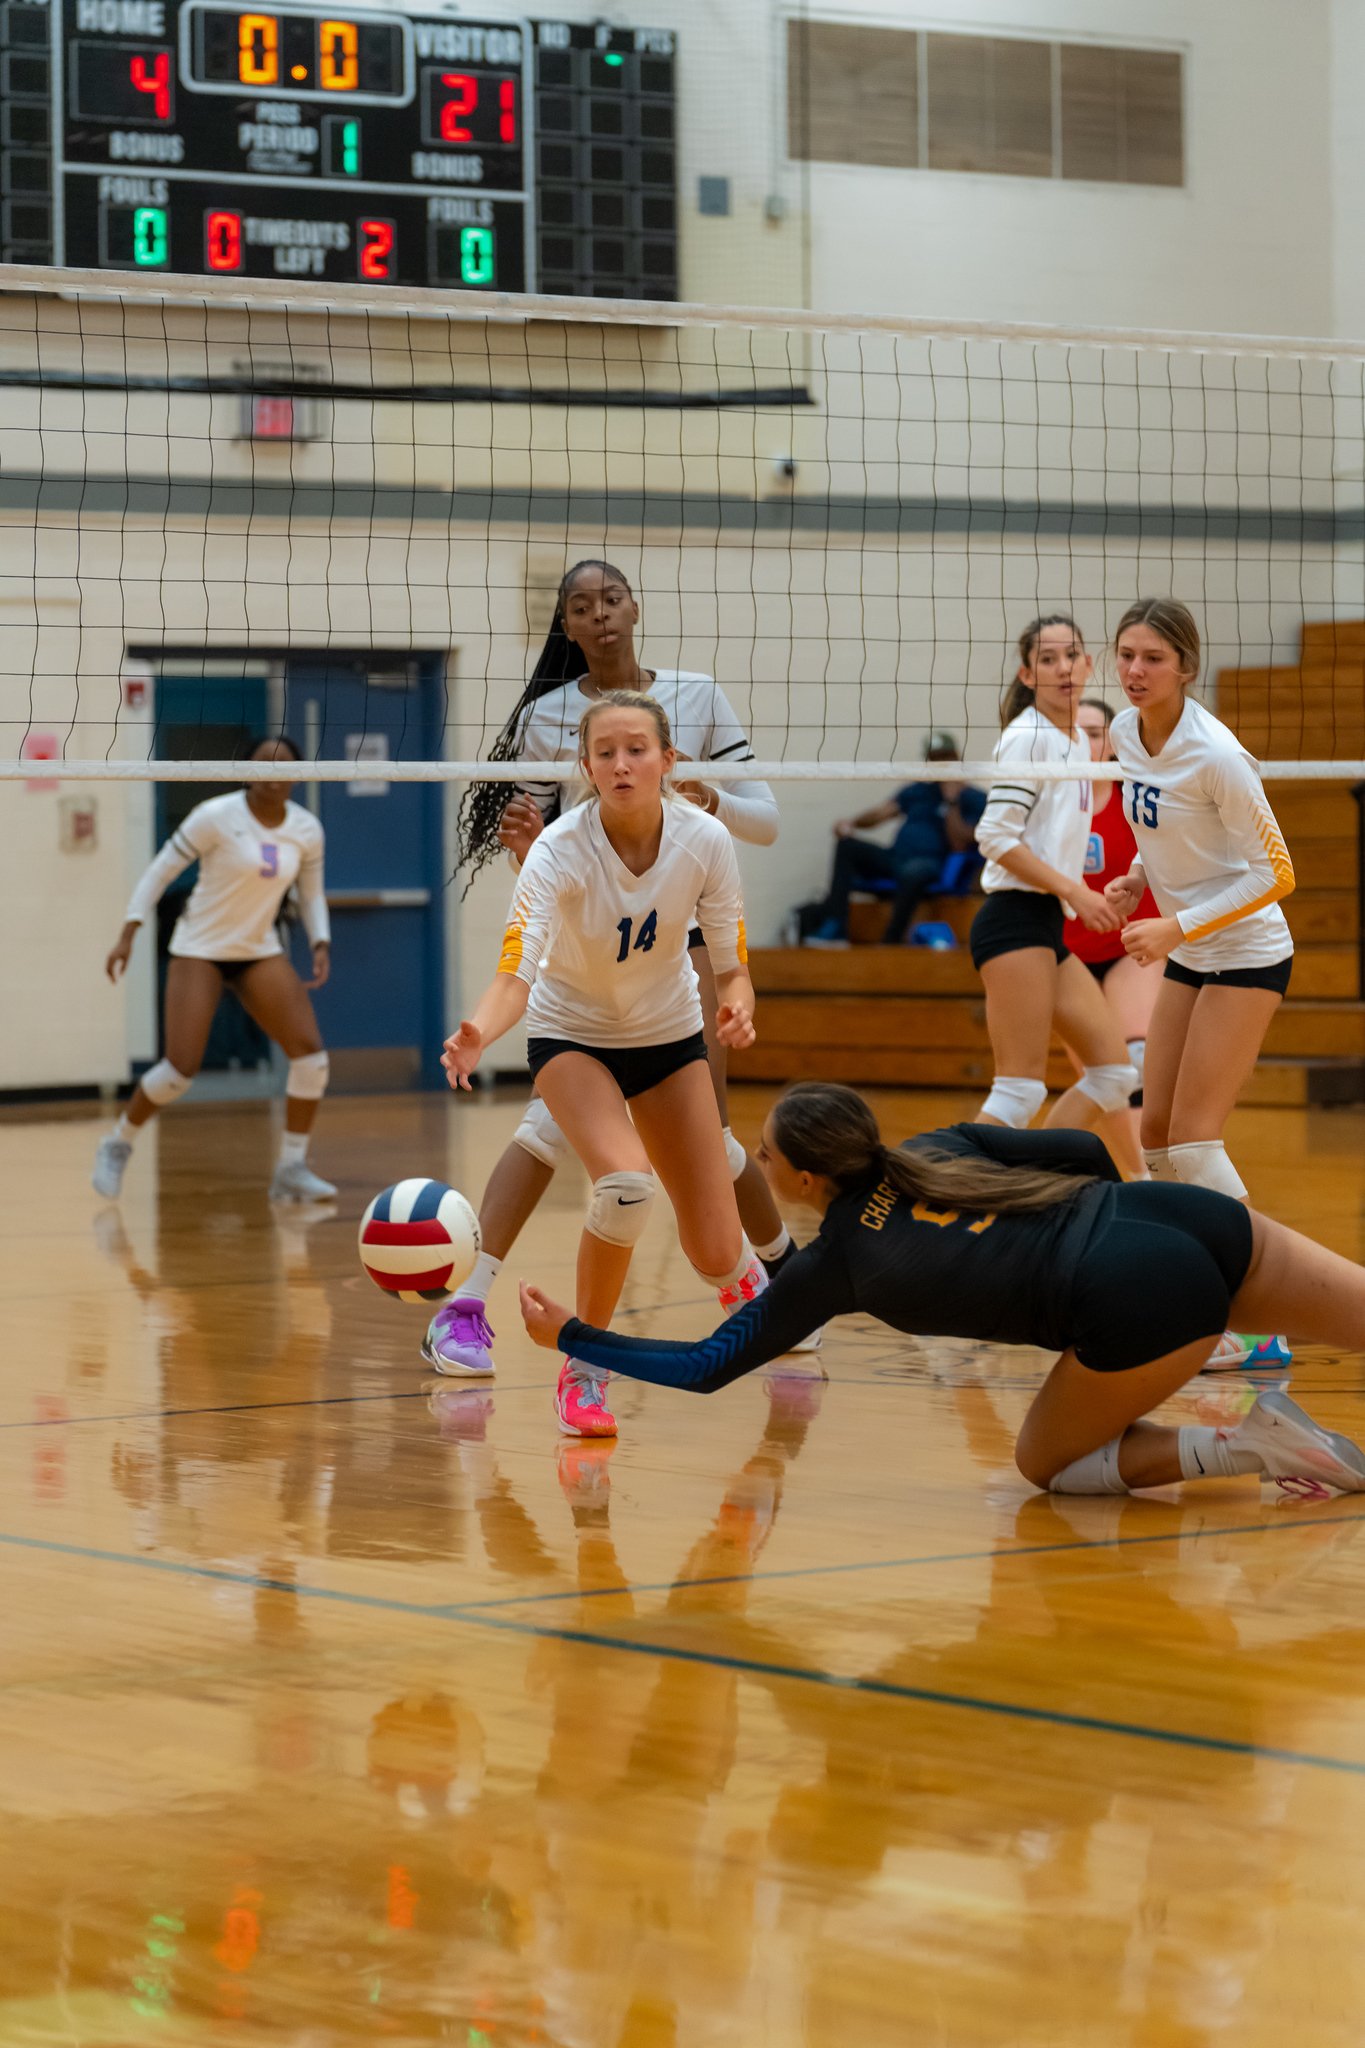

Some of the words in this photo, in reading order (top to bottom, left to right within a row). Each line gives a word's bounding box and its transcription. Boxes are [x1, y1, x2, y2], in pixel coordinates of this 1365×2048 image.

[76, 0, 165, 36] HOME
[413, 23, 521, 64] VISITOR
[130, 53, 170, 119] 4
[440, 73, 515, 144] 21
[108, 130, 185, 163] BONUS
[343, 121, 358, 176] 1
[411, 152, 484, 182] BONUS
[100, 176, 169, 206] FOULS
[427, 198, 494, 224] FOULS
[133, 207, 168, 266] 0
[207, 211, 242, 271] 0
[244, 216, 350, 250] TIMEOUTS
[361, 221, 394, 279] 2
[460, 227, 494, 284] 0
[273, 246, 327, 275] LEFT
[1132, 781, 1162, 830] 15
[616, 907, 658, 963] 14
[859, 1176, 901, 1232] CHAR
